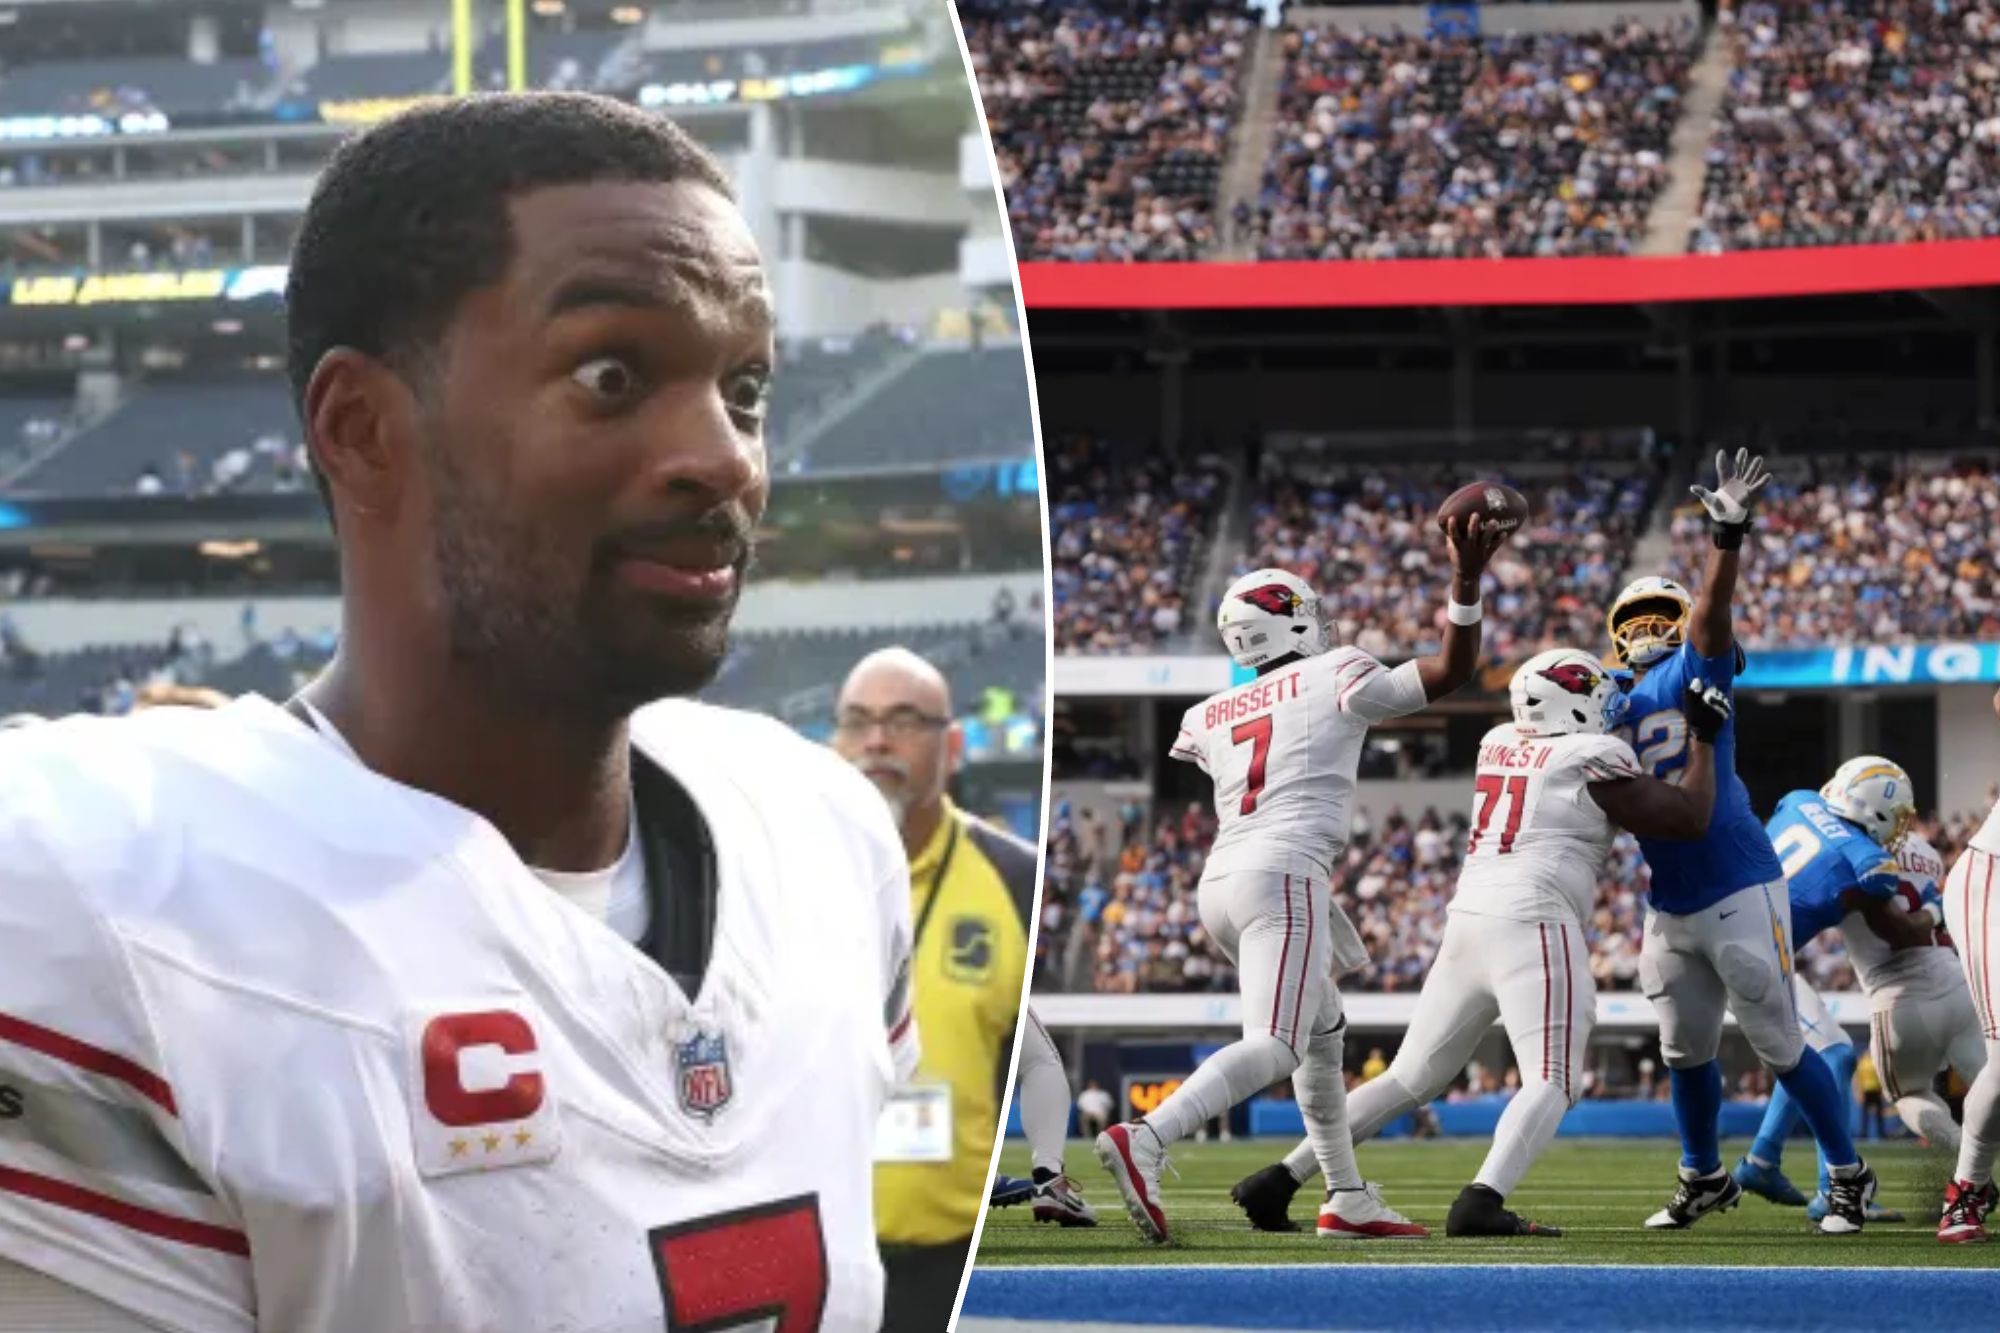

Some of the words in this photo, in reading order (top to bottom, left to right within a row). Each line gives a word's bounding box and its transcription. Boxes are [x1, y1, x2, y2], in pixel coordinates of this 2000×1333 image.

[1205, 672, 1300, 730] BRISSETT
[1231, 713, 1273, 816] 7
[1467, 774, 1528, 854] 71
[421, 1009, 546, 1128] C
[688, 1066, 728, 1106] NFL
[648, 1191, 831, 1333] 7
